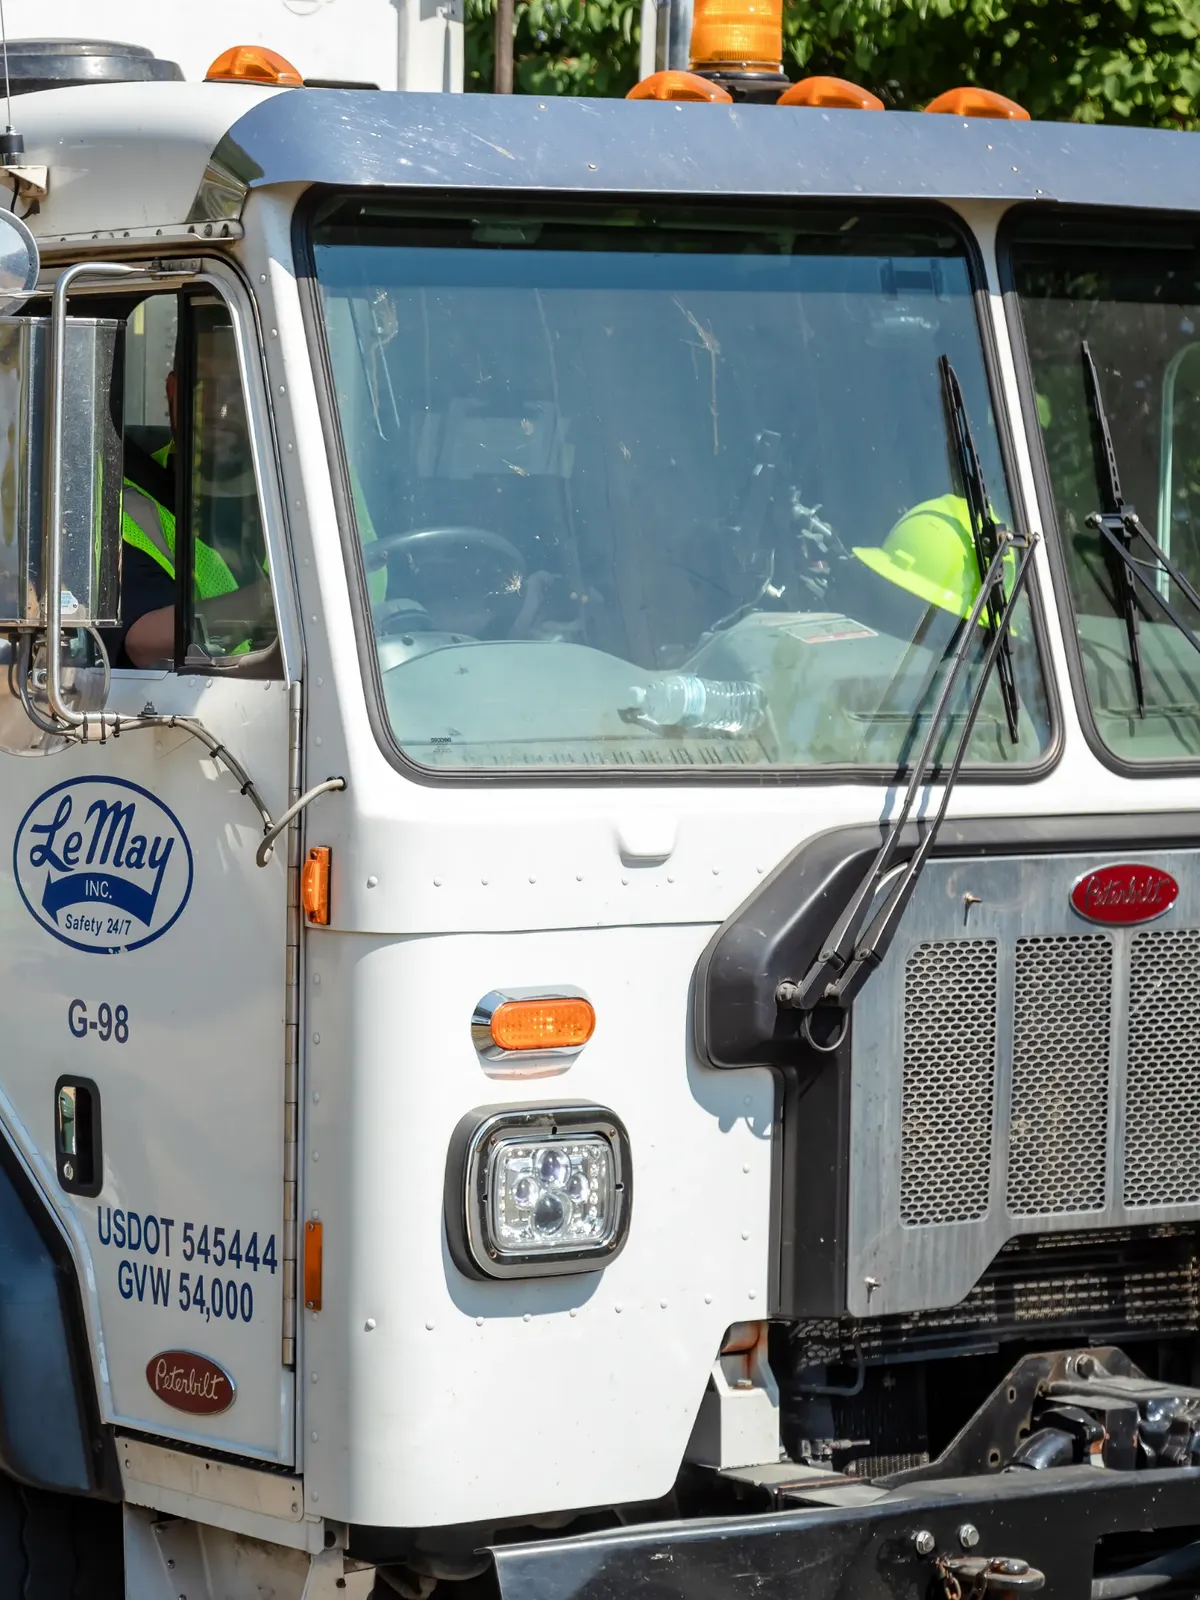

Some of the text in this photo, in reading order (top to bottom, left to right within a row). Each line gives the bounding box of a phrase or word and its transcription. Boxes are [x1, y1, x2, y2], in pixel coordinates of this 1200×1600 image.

[85, 880, 113, 900] INC.
[1085, 876, 1170, 911] Peterbilt
[65, 914, 133, 937] Safety 24/7
[68, 998, 129, 1044] G-98
[98, 1206, 278, 1274] USDOT 545444
[118, 1260, 253, 1323] GVW 54,000
[155, 1358, 224, 1400] Peterbilt
